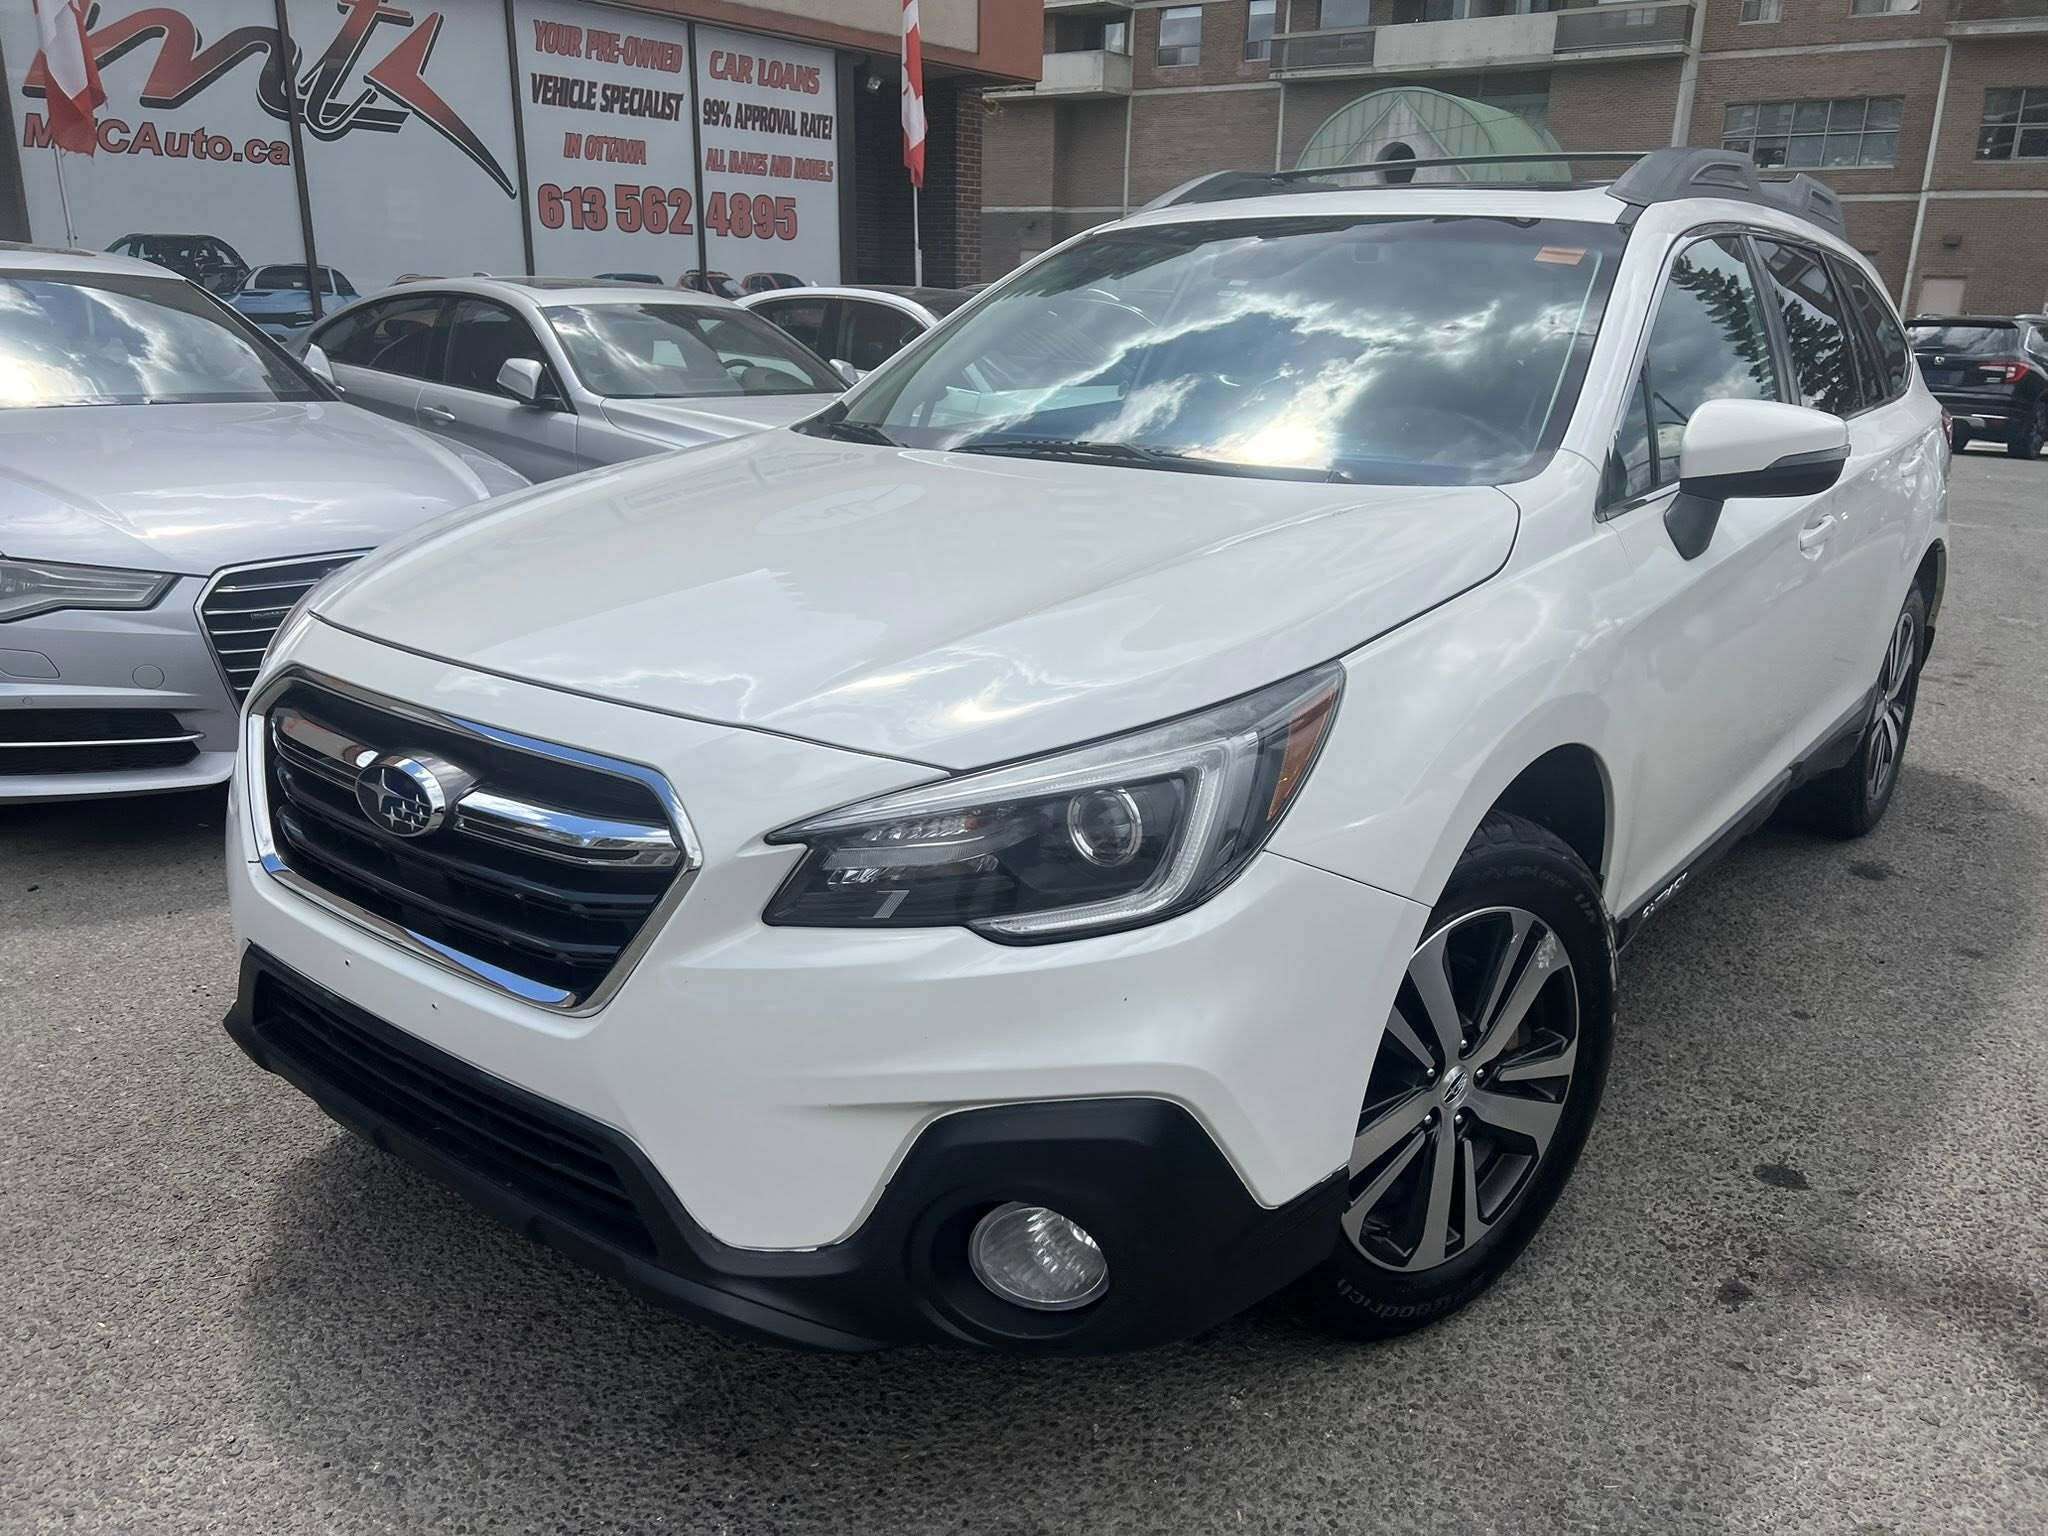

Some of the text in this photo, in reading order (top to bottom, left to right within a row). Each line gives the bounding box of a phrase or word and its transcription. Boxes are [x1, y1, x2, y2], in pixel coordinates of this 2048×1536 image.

[533, 19, 684, 73] YOUR PRE-OWNED
[709, 50, 820, 95] CAR LOANS
[531, 73, 684, 121] VEHICLE SPECIALIST
[703, 98, 834, 140] 99% APPROVAL RATE!
[23, 112, 291, 166] MCAuto.ca
[563, 132, 647, 166] IN OTTAWA
[705, 147, 834, 182] ALL MAKES AND MODELS
[537, 183, 798, 241] 613 562 4895
